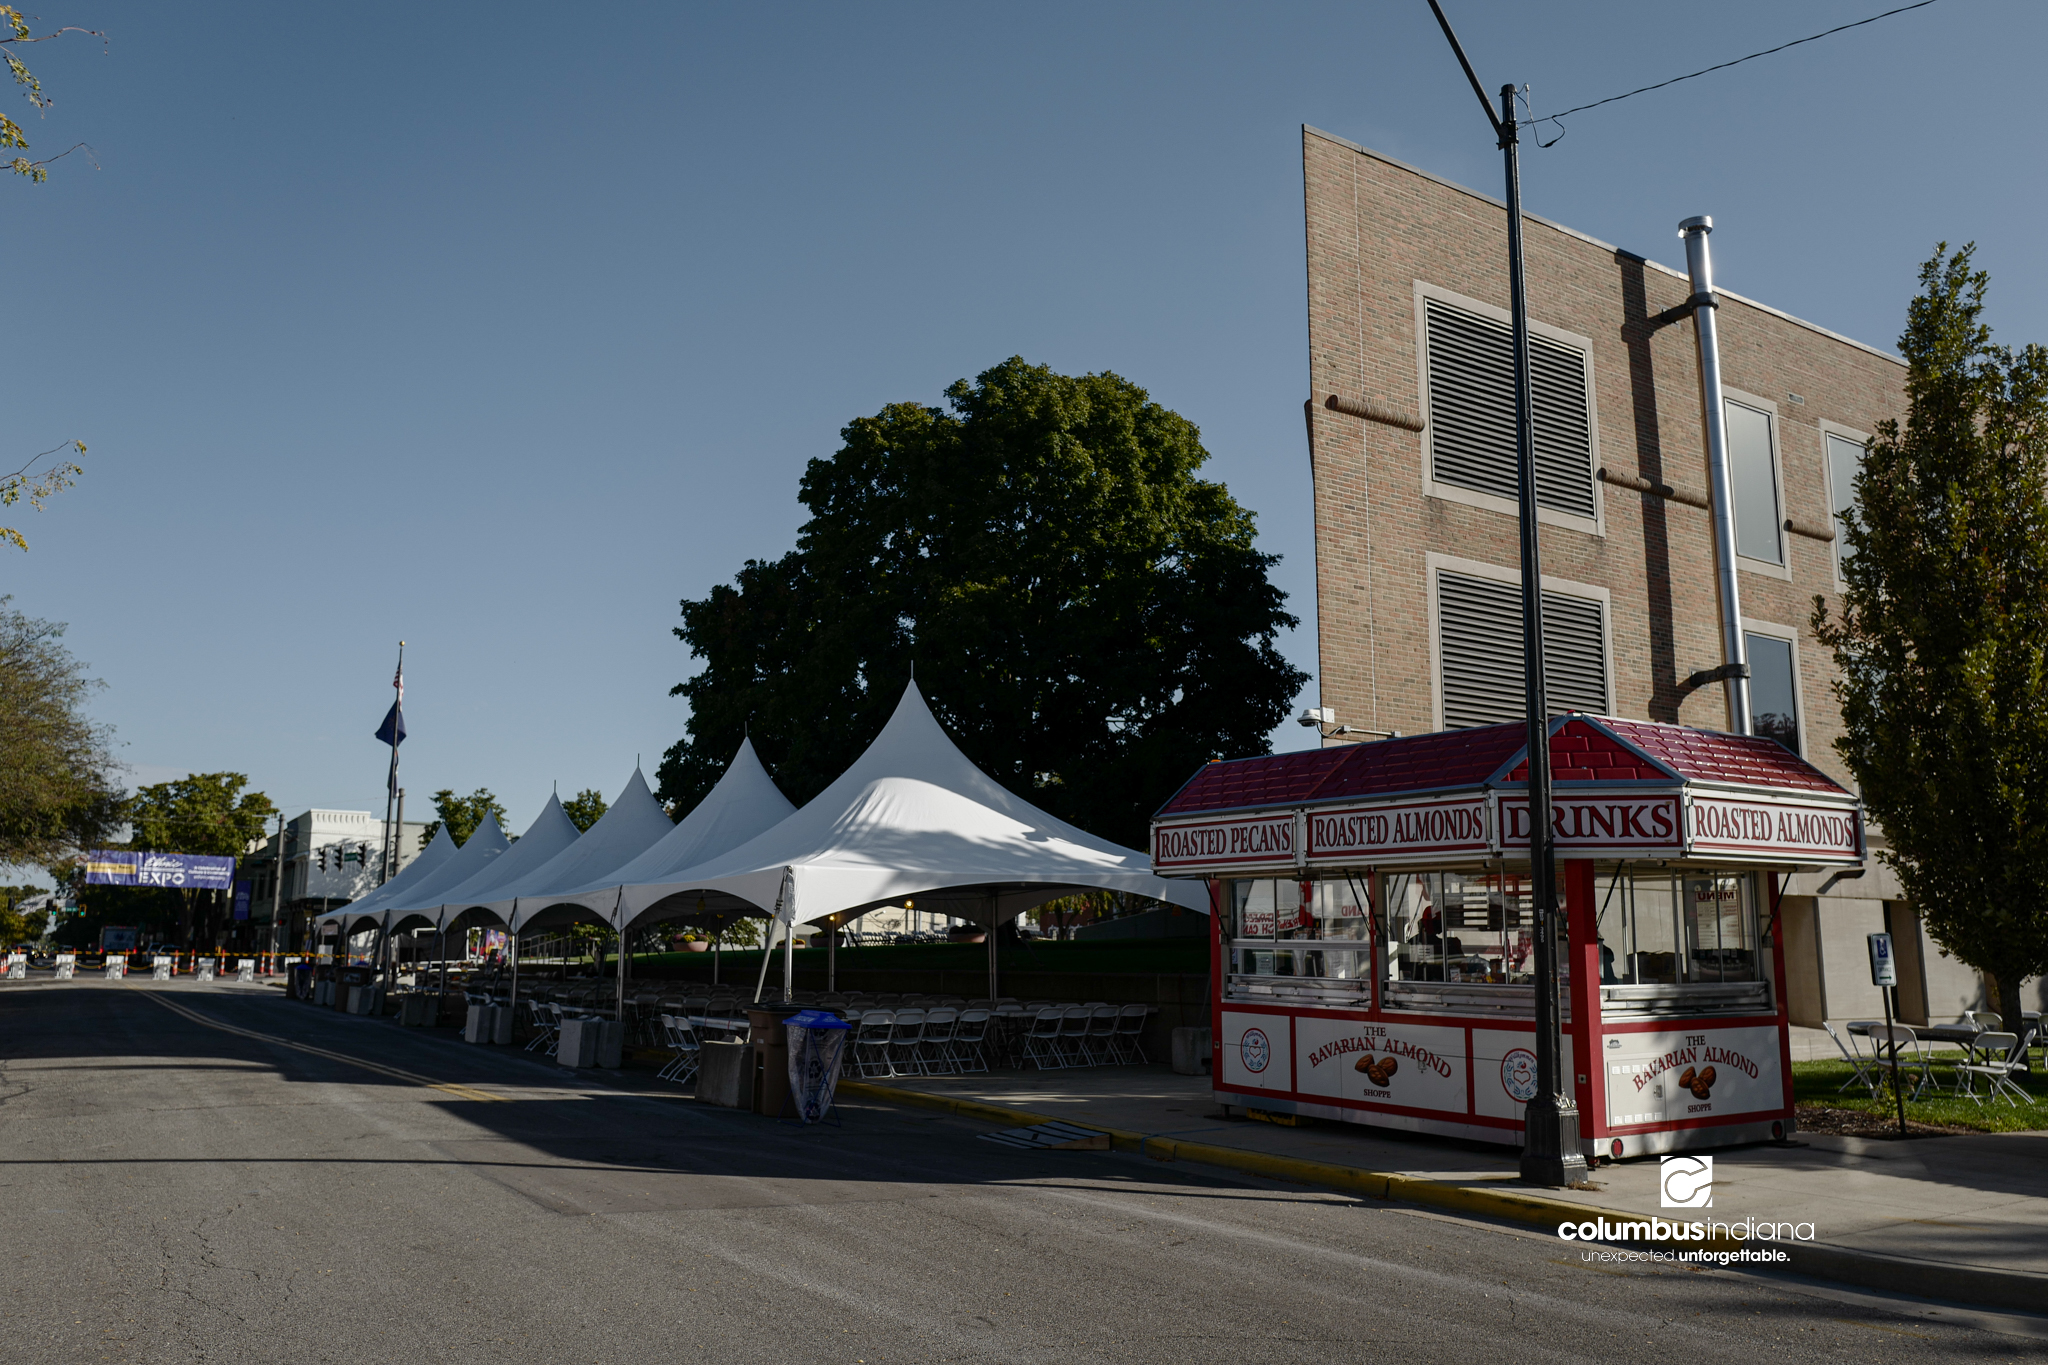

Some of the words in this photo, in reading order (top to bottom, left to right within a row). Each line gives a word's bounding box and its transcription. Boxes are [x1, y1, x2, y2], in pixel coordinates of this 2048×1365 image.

[1315, 814, 1388, 847] ROASTED
[1393, 806, 1483, 844] ALMONDS
[1507, 804, 1673, 838] DRINKS
[1695, 805, 1772, 841] ROASTED
[1777, 811, 1854, 847] ALMONDS
[1161, 828, 1226, 858] ROASTED
[1230, 822, 1290, 854] PECANS
[138, 871, 185, 886] EXPO
[1364, 1026, 1386, 1037] THE
[1686, 1035, 1705, 1046] THE
[1308, 1036, 1376, 1068] BAVARIAN
[1383, 1038, 1451, 1078] ALMOND
[1632, 1046, 1697, 1092] BAVARIAN
[1703, 1046, 1758, 1079] ALMOND
[1363, 1089, 1391, 1099] SHOPPE
[1687, 1103, 1712, 1113] SHOPPE
